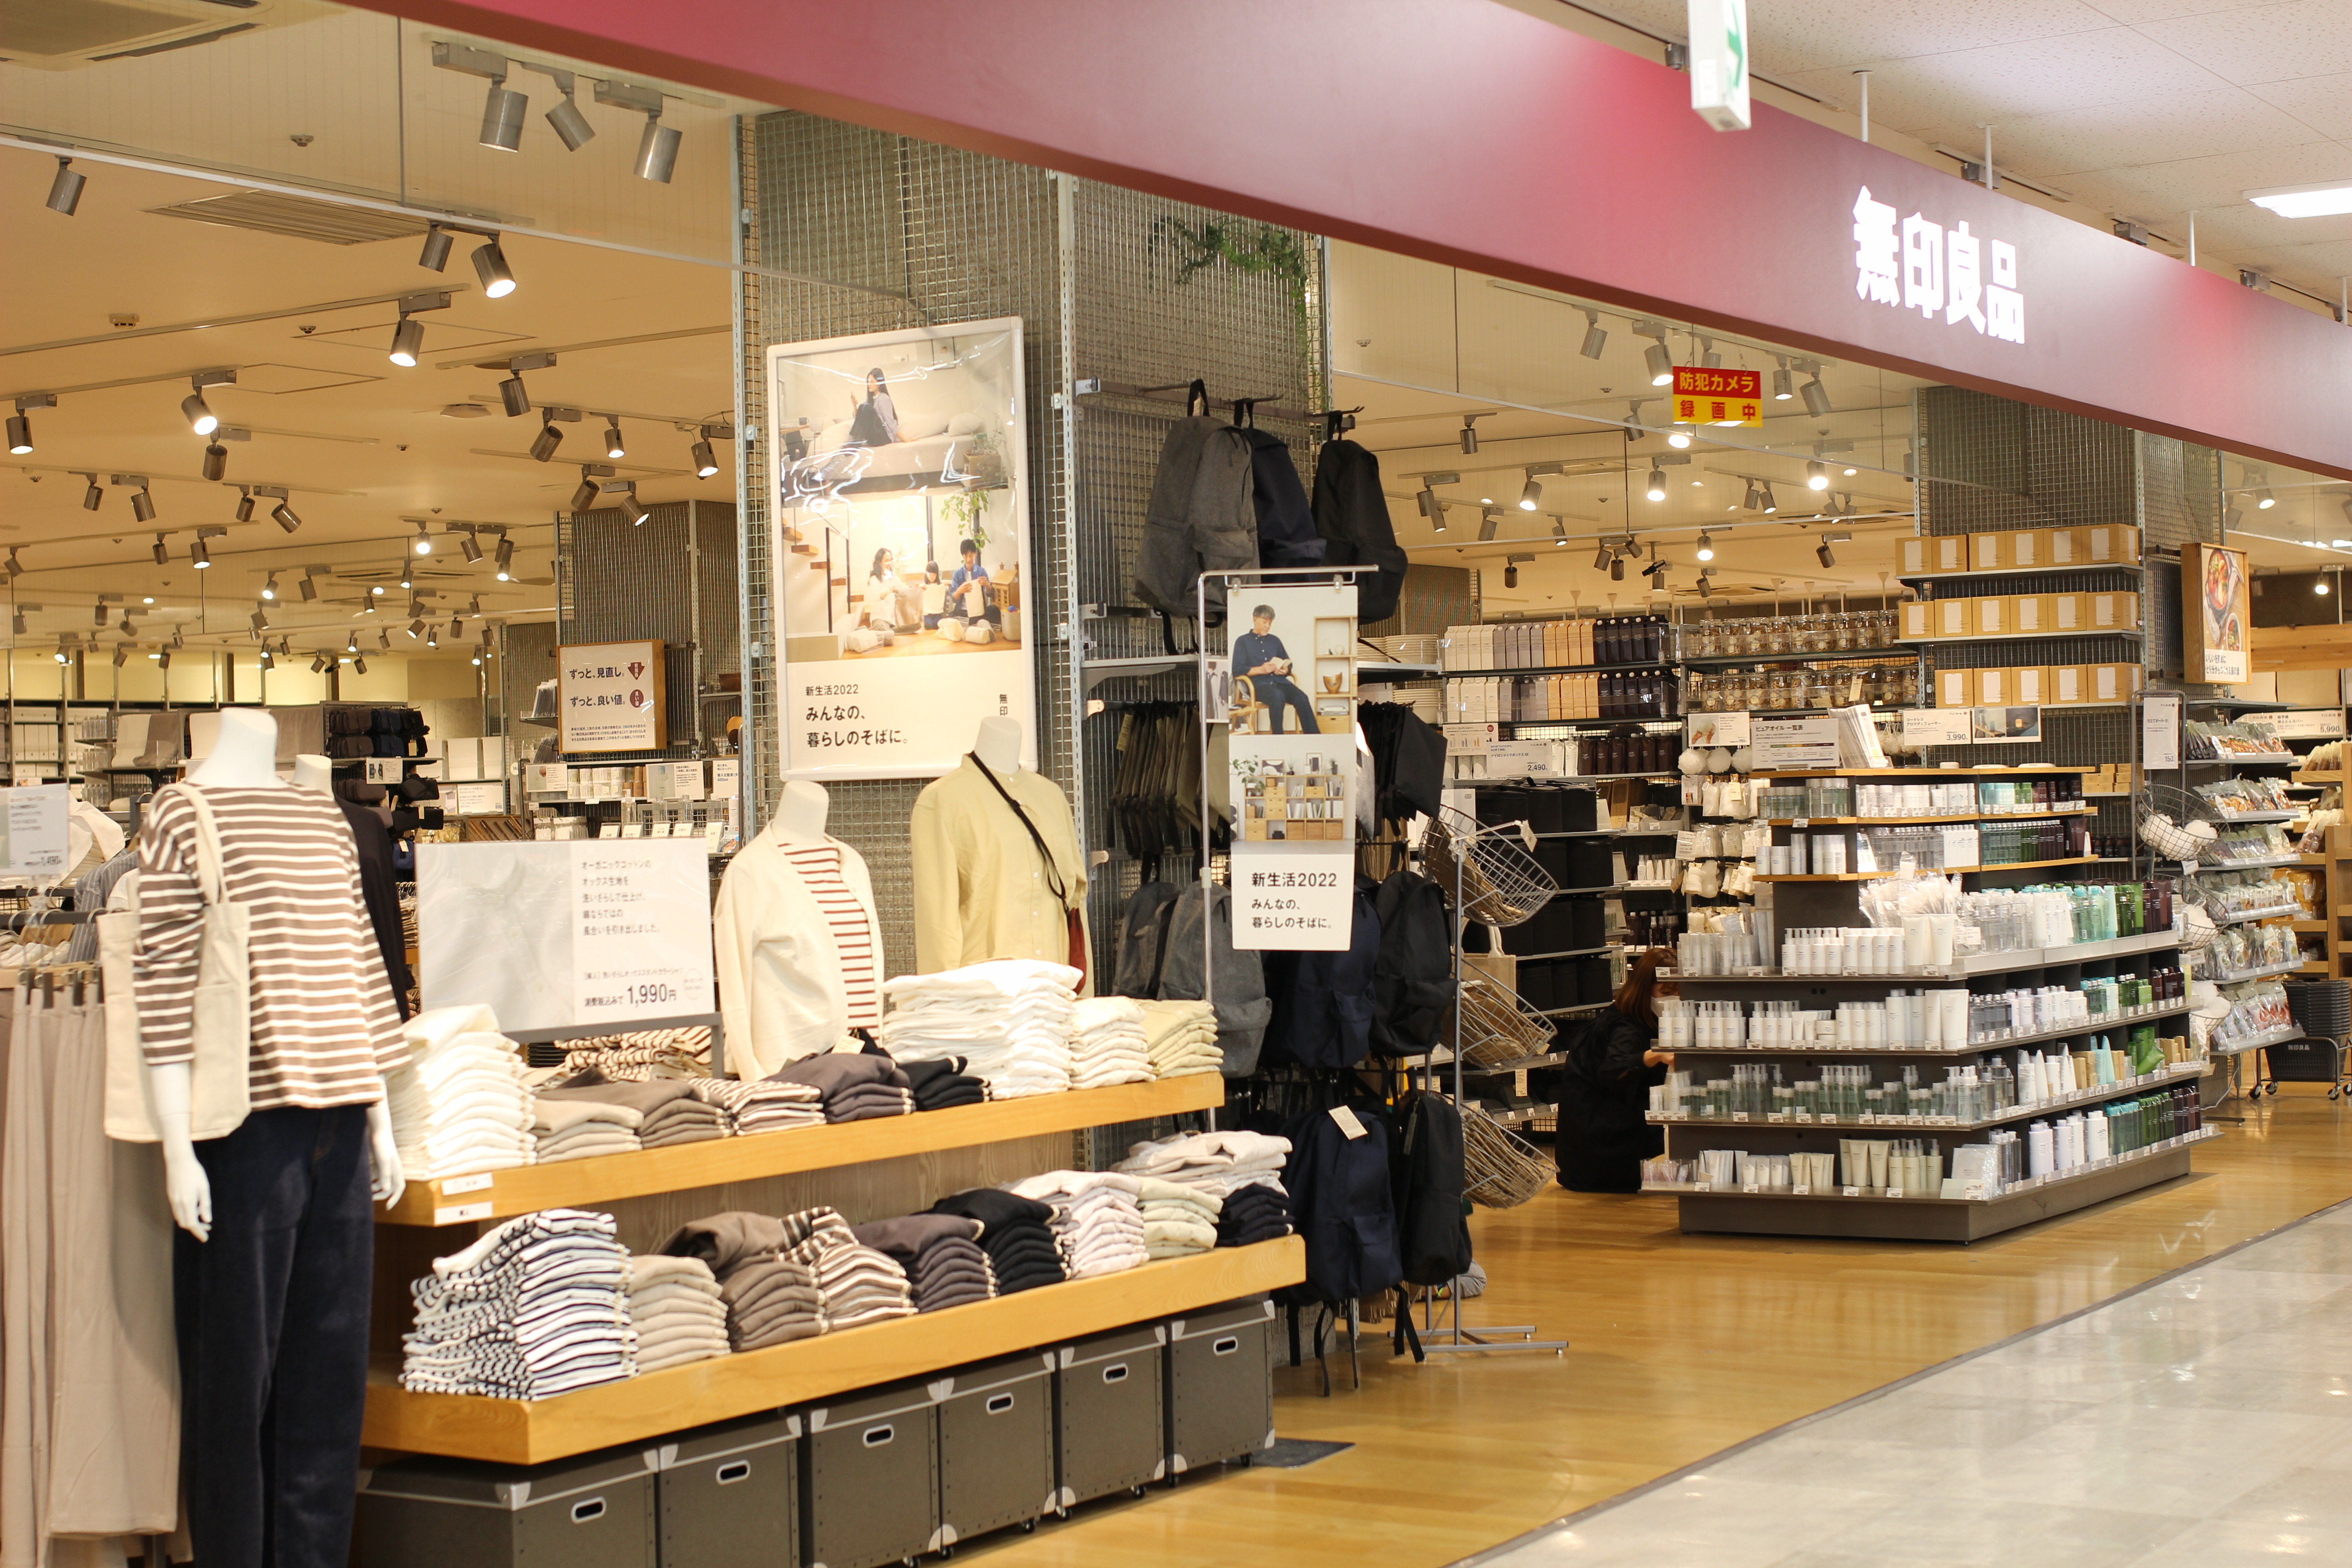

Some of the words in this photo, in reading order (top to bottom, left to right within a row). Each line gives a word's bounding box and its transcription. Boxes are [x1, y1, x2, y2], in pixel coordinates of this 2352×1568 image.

[1852, 185, 2025, 344] 無印良品
[1679, 372, 1754, 393] 防犯カメラ
[1680, 400, 1756, 421] 録画中
[569, 666, 625, 680] ずっと、見直し。
[805, 684, 859, 697] 新生活2022
[570, 694, 625, 707] ずっと、良い値。
[805, 705, 866, 721] みんなの、
[807, 729, 908, 748] 暮らしのそばに。
[1251, 872, 1338, 888] 新生活2022
[1251, 898, 1301, 910] みんなの、
[1251, 916, 1333, 930] 暮らしのそばに。
[627, 983, 677, 1008] 1,990円
